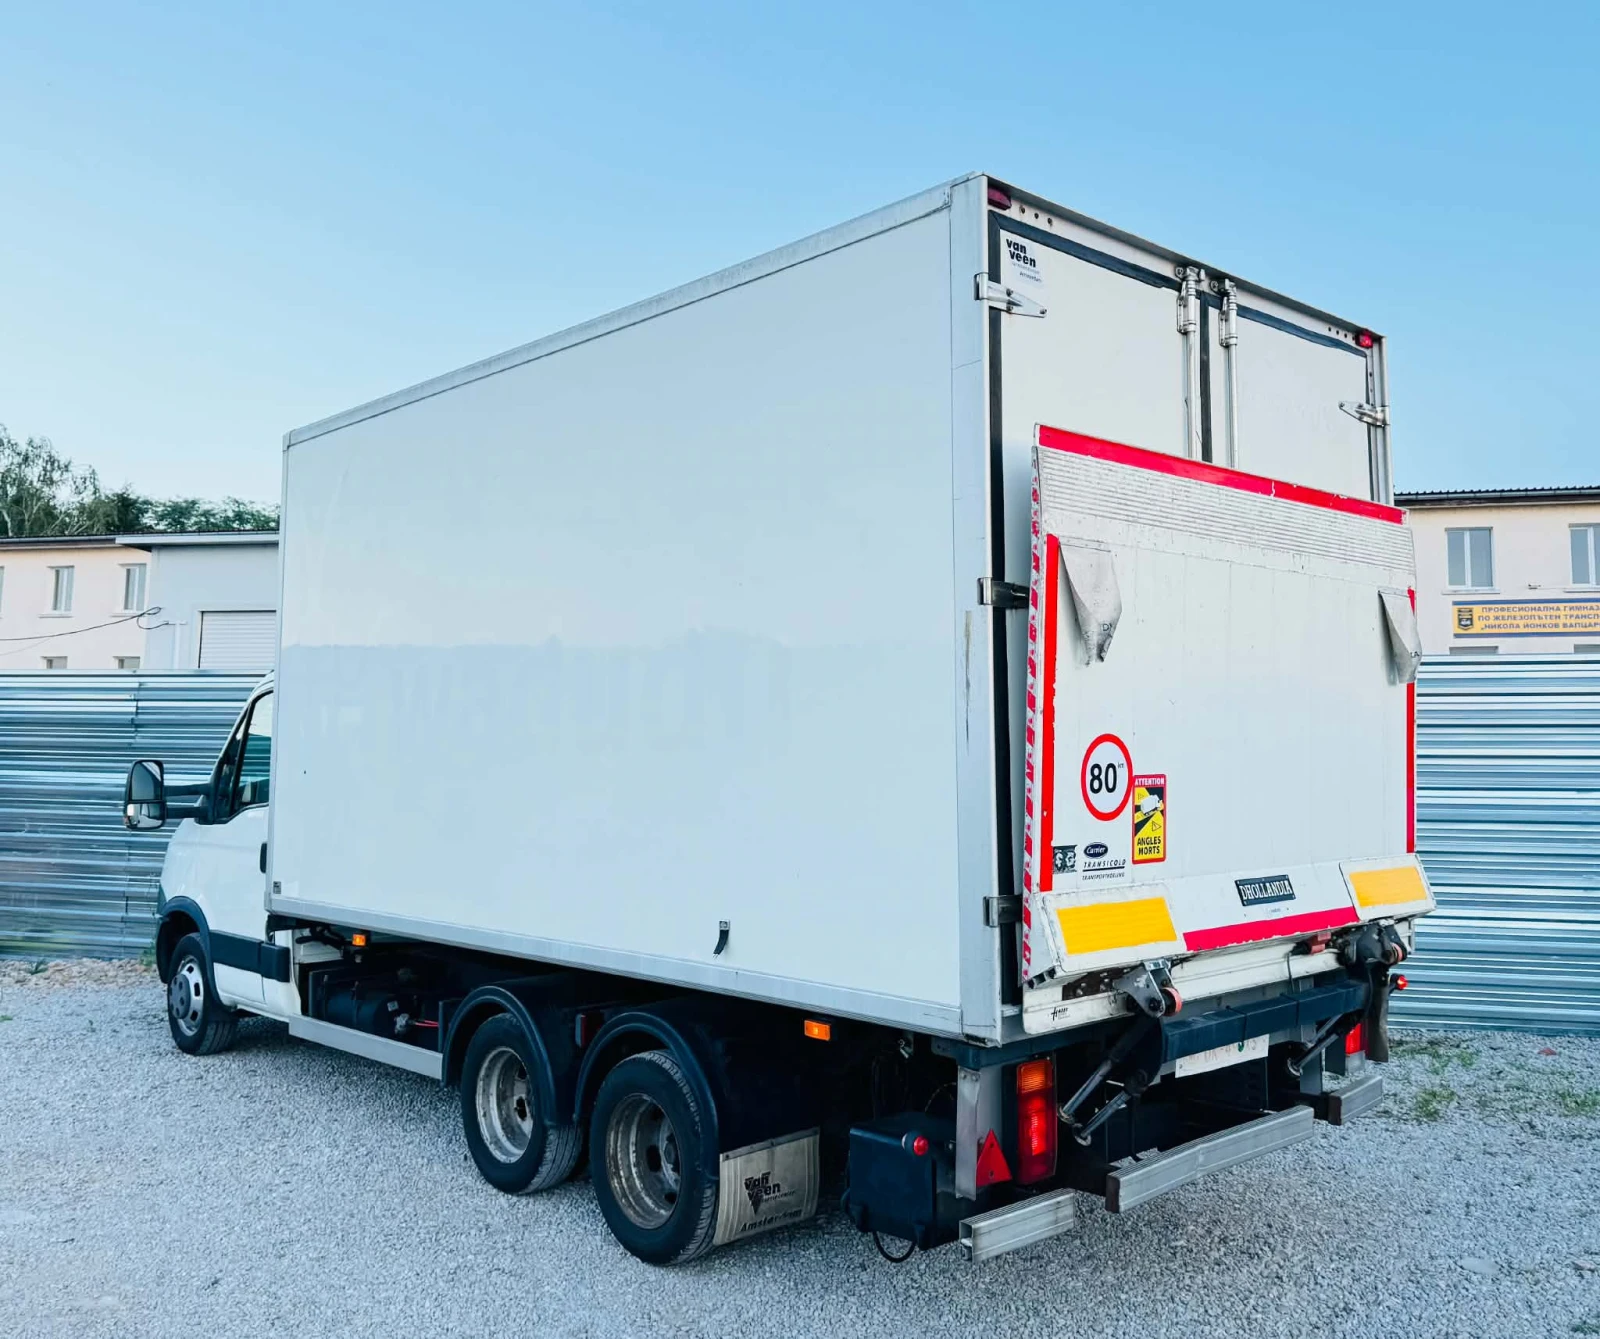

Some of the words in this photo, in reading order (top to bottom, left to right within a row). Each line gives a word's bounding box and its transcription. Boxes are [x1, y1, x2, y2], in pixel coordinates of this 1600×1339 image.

[1006, 239, 1027, 254] van
[1009, 250, 1036, 268] veen
[1482, 605, 1560, 613] ПРОФЕСИОНАЛНА
[1089, 763, 1117, 794] 80
[1134, 777, 1165, 786] ATTENTION
[1136, 836, 1162, 847] ANGLES
[1086, 846, 1106, 854] Carrier
[1138, 846, 1161, 856] MORTS
[1083, 859, 1126, 869] TRANSICOLD
[1239, 880, 1292, 900] DHOLLANDIA
